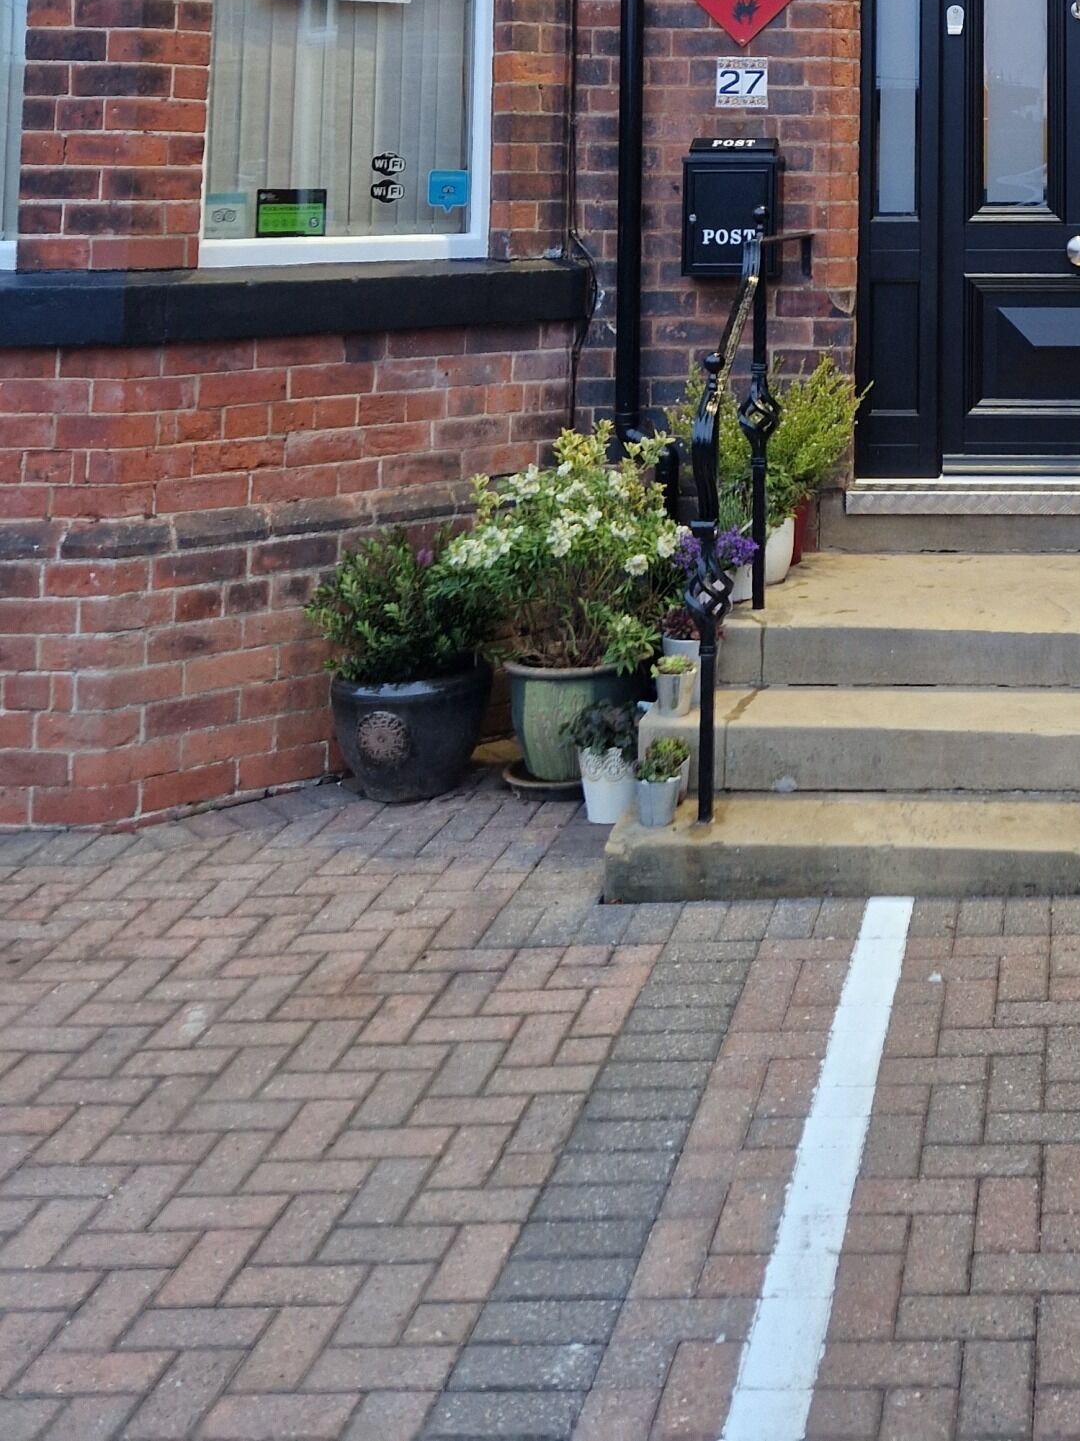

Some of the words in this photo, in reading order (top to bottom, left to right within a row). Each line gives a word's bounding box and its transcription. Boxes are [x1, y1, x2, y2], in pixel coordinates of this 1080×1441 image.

[719, 70, 765, 94] 27
[712, 139, 756, 147] POST
[703, 229, 756, 244] POST
